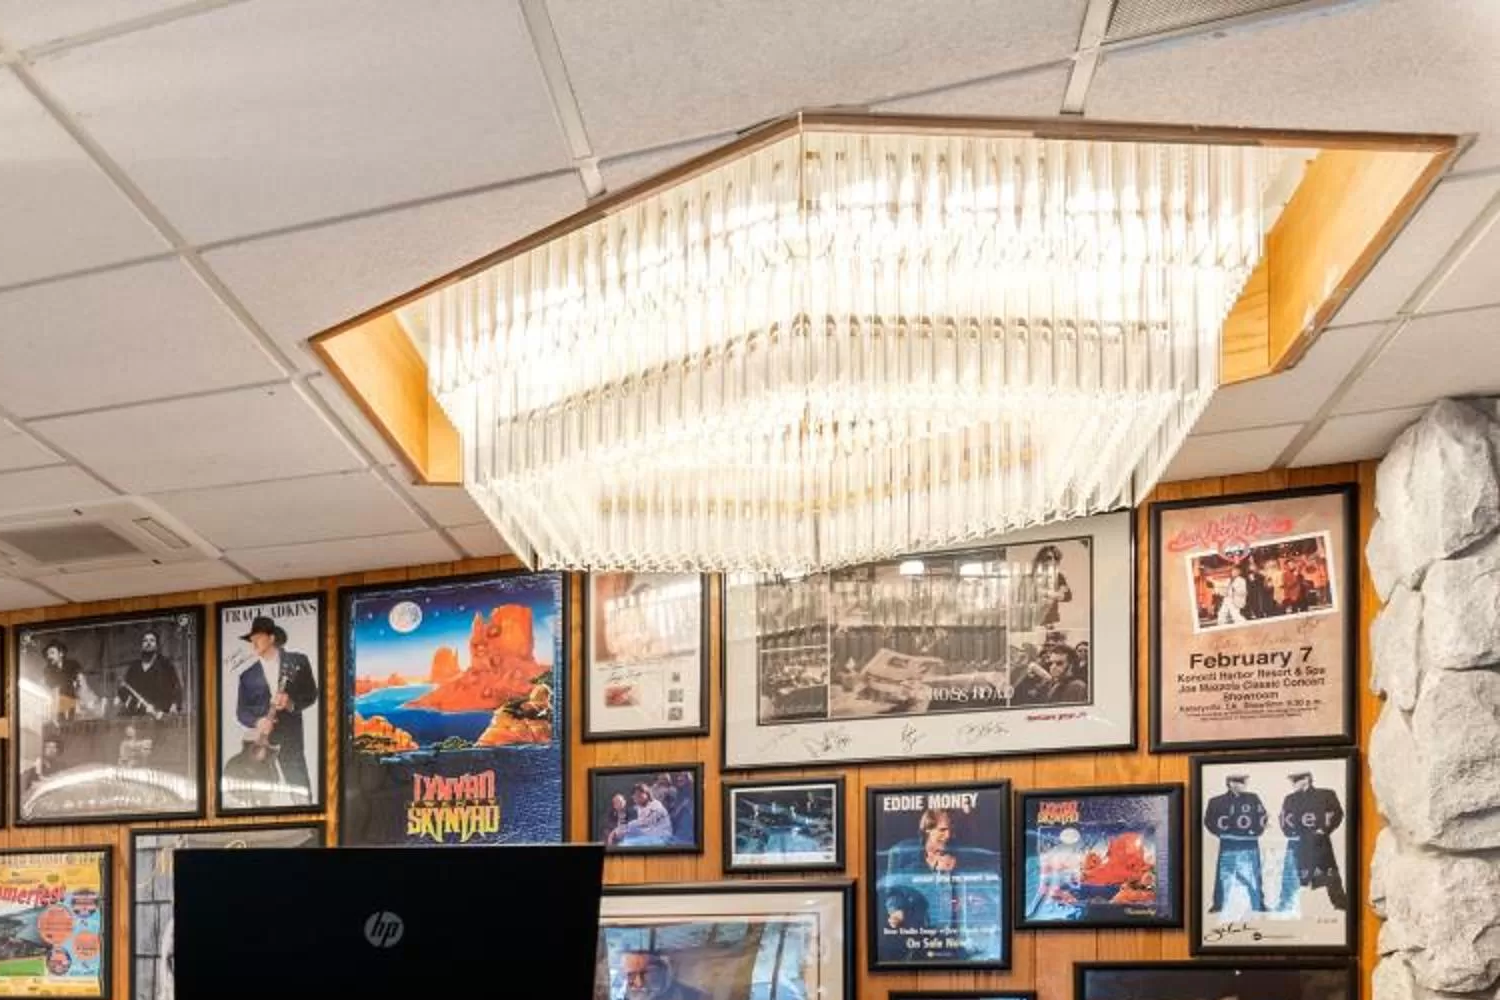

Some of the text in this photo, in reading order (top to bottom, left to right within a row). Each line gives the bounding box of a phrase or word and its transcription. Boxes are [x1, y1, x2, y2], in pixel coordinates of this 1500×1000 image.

[270, 602, 317, 619] ADKINS
[1189, 646, 1313, 669] February 7
[1219, 670, 1254, 681] Harbor
[1258, 668, 1291, 679] Resort
[1283, 677, 1326, 688] Concert
[883, 792, 979, 811] EDDIE MONEY
[406, 804, 500, 843] SKYNYRD
[368, 911, 401, 948] hp
[906, 938, 921, 949] On
[923, 937, 943, 949] Sale
